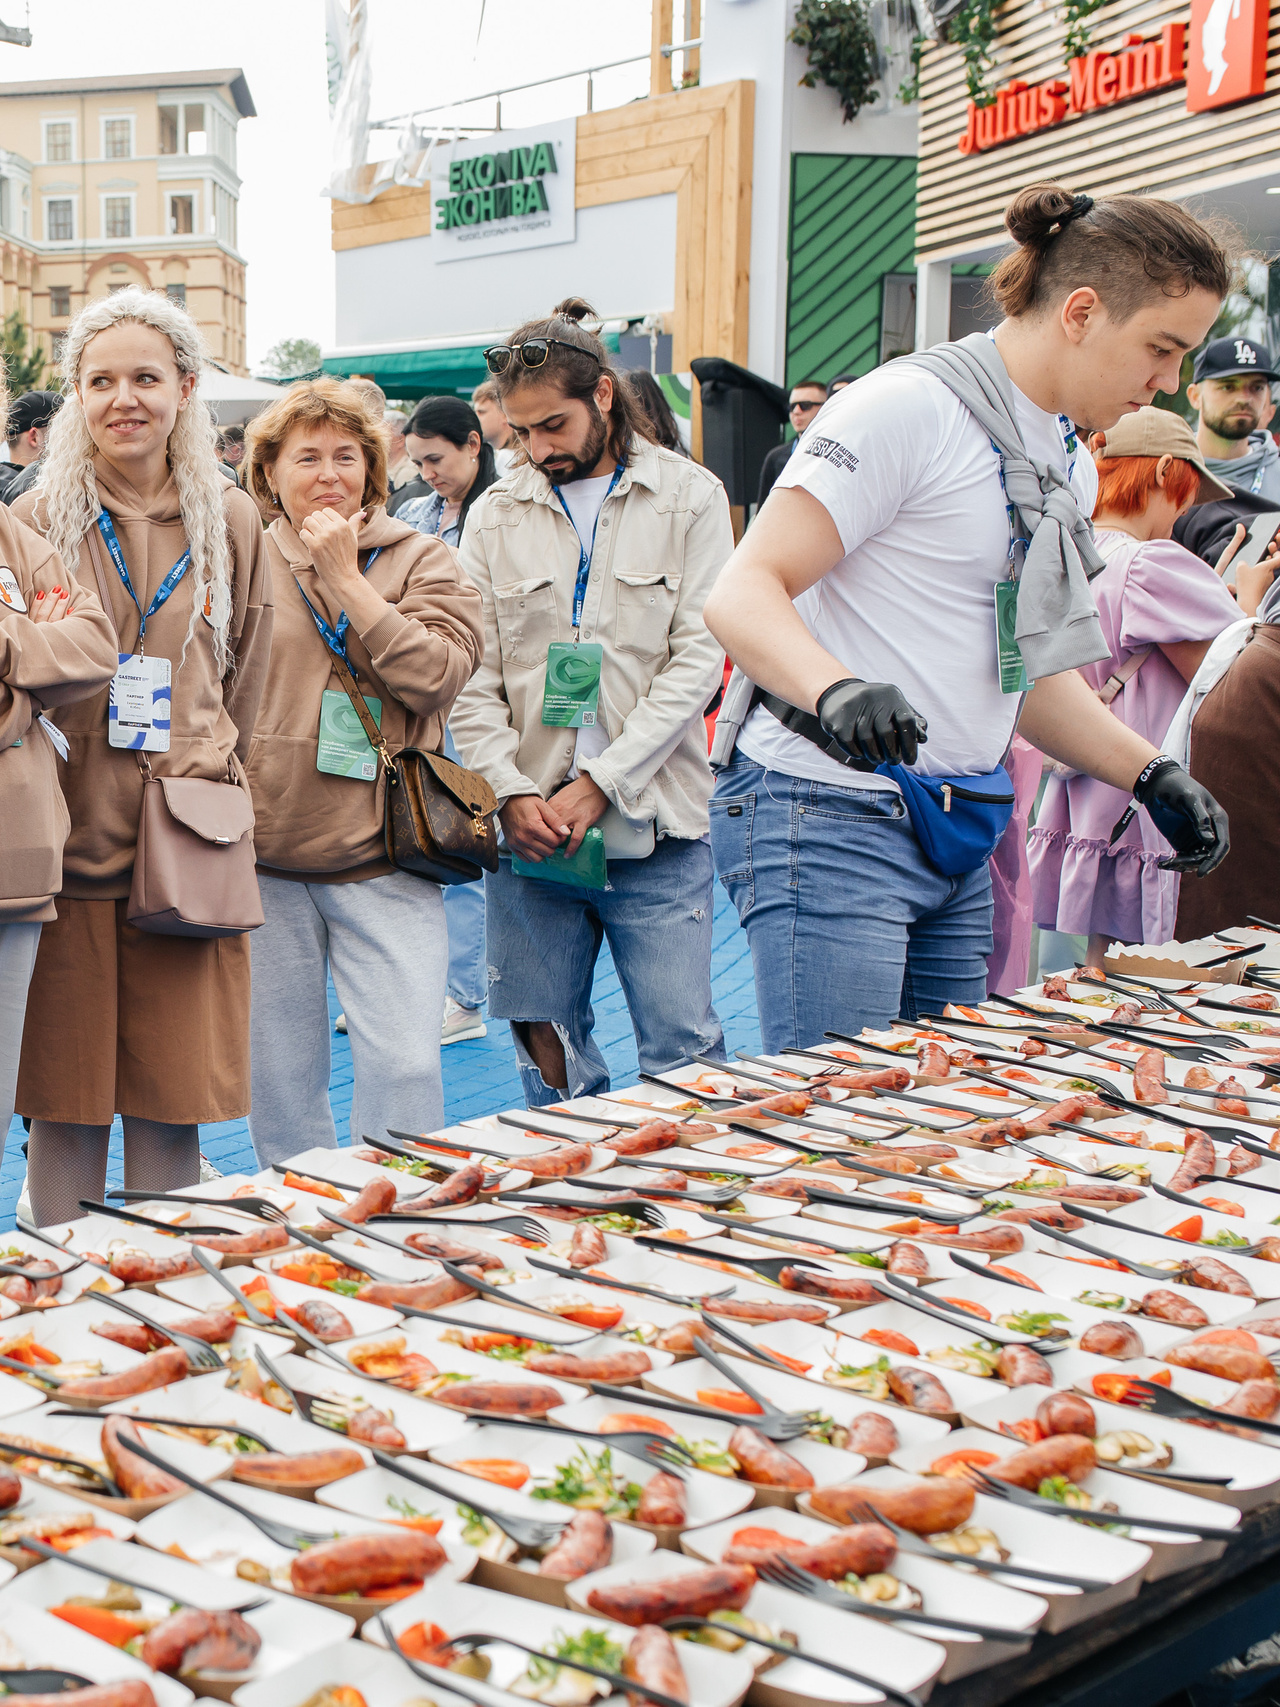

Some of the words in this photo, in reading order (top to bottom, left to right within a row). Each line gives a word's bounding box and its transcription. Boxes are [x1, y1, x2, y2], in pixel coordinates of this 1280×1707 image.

[958, 79, 1066, 154] Julius
[1068, 23, 1186, 113] Meinl
[449, 142, 558, 193] EKONIVA
[435, 180, 549, 230] ЭКОНИВА
[1234, 340, 1257, 364] LA
[832, 450, 857, 473] FIVE-STARS
[838, 445, 860, 465] GASTREET
[112, 547, 126, 577] GASTREET
[171, 554, 190, 580] GASTREET
